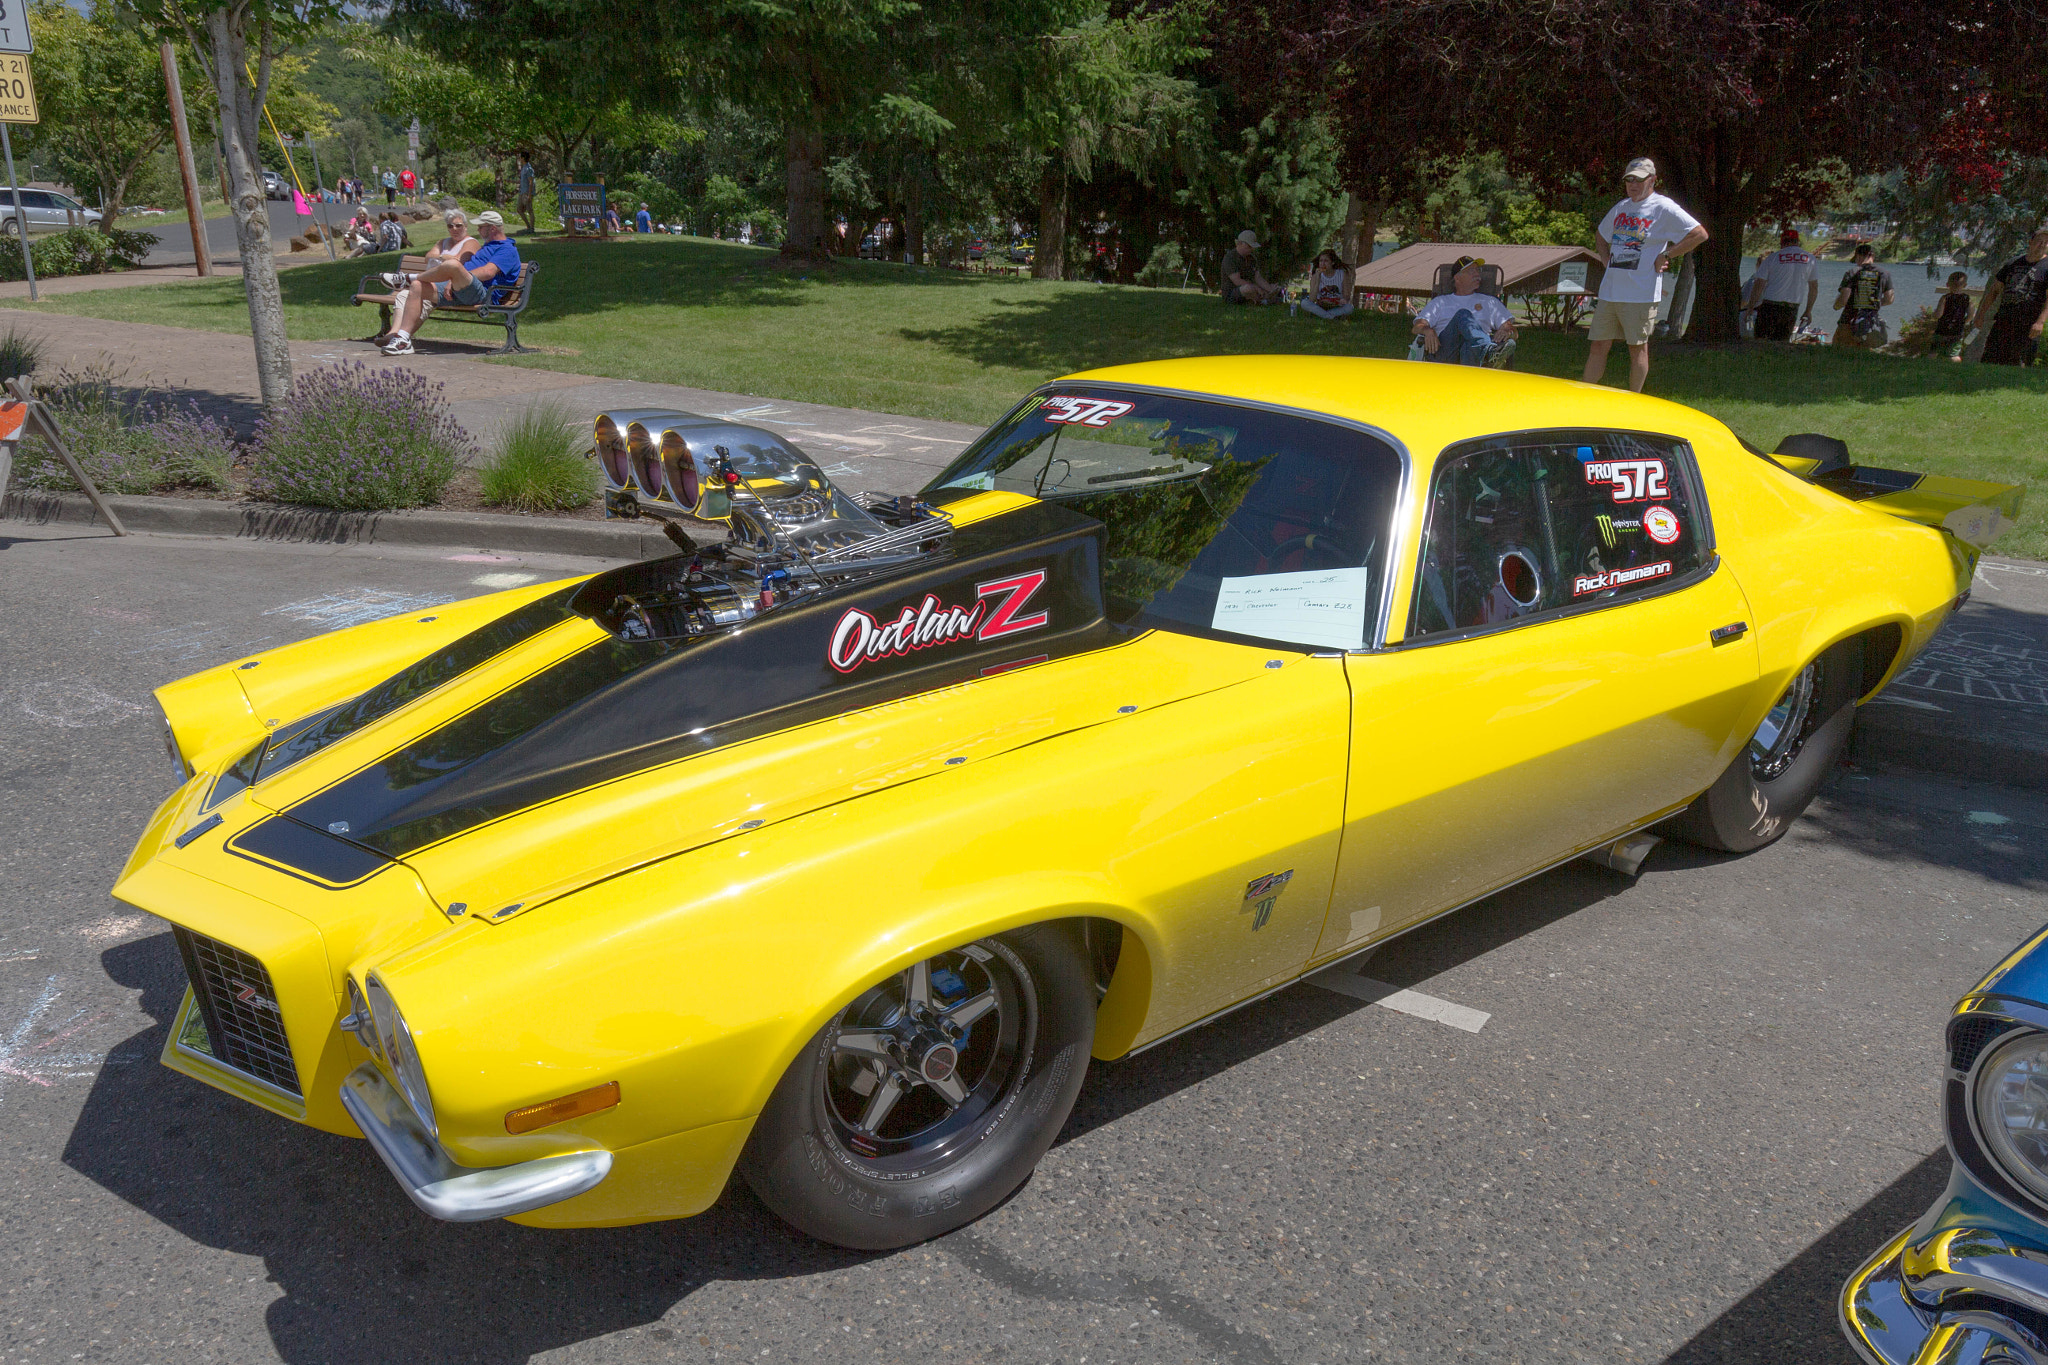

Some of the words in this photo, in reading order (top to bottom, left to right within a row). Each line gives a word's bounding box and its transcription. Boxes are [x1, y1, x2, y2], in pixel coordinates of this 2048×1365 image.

[11, 60, 23, 73] 21
[565, 191, 597, 200] HORSESHOE
[563, 204, 581, 214] LAKE
[582, 204, 601, 215] PARK
[1043, 397, 1075, 407] PRO
[1047, 398, 1133, 426] 572
[1586, 463, 1611, 480] PRO
[1610, 460, 1667, 500] 572
[1575, 573, 1609, 593] Rick
[831, 596, 981, 668] Outlaw
[977, 570, 1049, 642] Z
[823, 1133, 879, 1179] SPECIALTIES
[879, 1171, 920, 1180] BILLET
